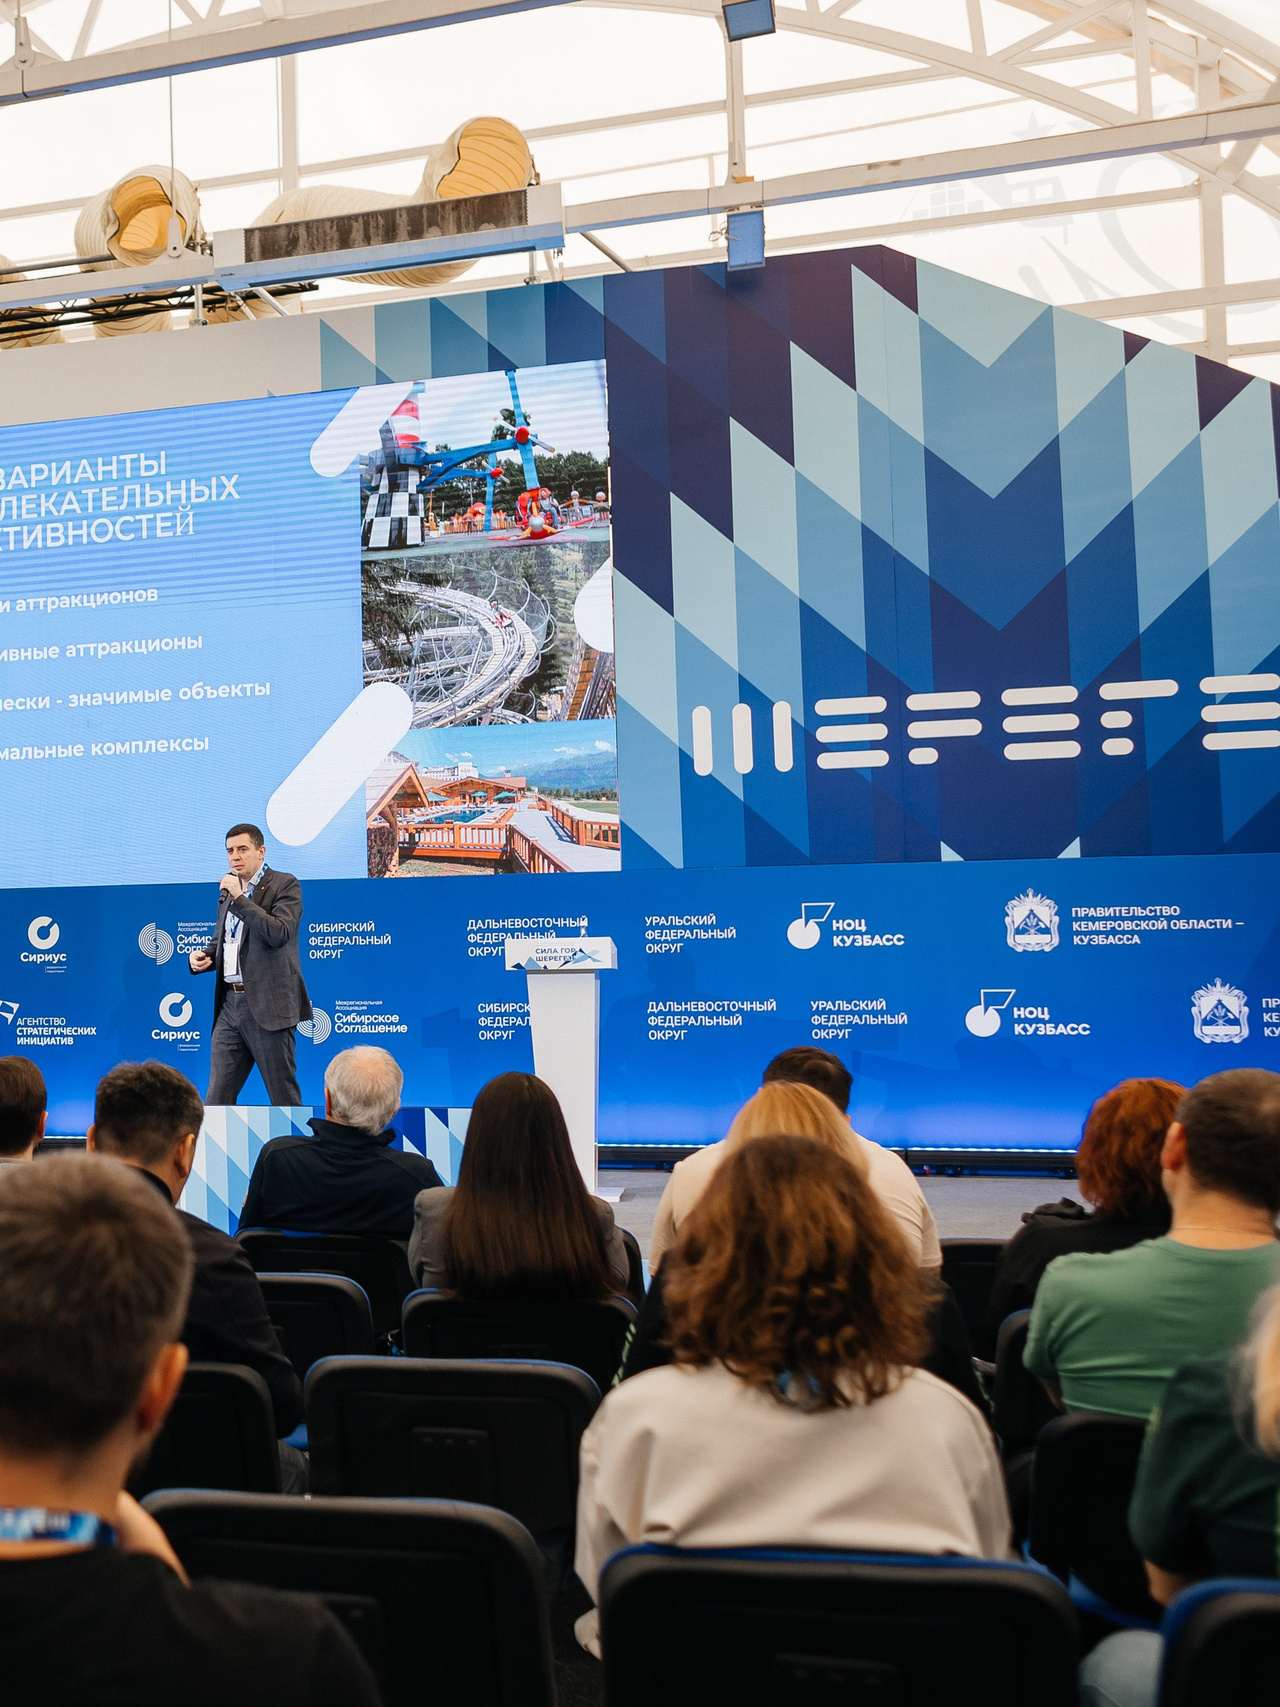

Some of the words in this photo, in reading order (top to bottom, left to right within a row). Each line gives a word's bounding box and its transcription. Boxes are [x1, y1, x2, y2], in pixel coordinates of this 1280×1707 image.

[15, 587, 159, 613] аттракционов
[65, 635, 203, 660] аттракционы
[68, 687, 172, 708] значимые
[179, 681, 271, 701] объекты
[91, 735, 210, 759] комплексы
[1072, 905, 1180, 918] ПРАВИТЕЛЬСТВО
[467, 915, 588, 931] ДАЛЬНЕВОСТОЧНЫЙ
[645, 913, 716, 926] УРАЛЬСКИЙ
[832, 919, 867, 932] НОЦ
[1072, 918, 1168, 931] КЕМЕРОВСКОЙ
[1170, 919, 1232, 930] ОБЛАСТИ
[308, 920, 375, 933] СИБИРСКИЙ
[177, 934, 212, 945] Сибир
[308, 934, 392, 947] ФЕДЕРАЛЬНЫЙ
[645, 927, 736, 941] ФЕДЕРАЛЬНЫЙ
[833, 934, 905, 947] КУЗБАСС
[1073, 935, 1141, 945] КУЗБАССА
[309, 949, 344, 960] ОКРУГ
[468, 946, 505, 957] ОКРУГ
[645, 943, 683, 954] ОКРУГ
[20, 952, 67, 964] Сириус
[478, 1003, 530, 1013] СИБИРСК
[647, 999, 777, 1014] ДАЛЬНЕВОСТОЧНЫЙ
[811, 998, 886, 1011] УРАЛЬСКИЙ
[334, 1012, 400, 1025] Сибирское
[811, 1012, 908, 1027] ФЕДЕРАЛЬНЫЙ
[1013, 1006, 1050, 1021] НОЦ
[17, 1017, 66, 1026] АГЕНТСТВО
[478, 1016, 531, 1028] ФЕДЕРАЛ
[647, 1014, 742, 1028] ФЕДЕРАЛЬНЫЙ
[16, 1026, 97, 1036] СТРАТЕГИЧЕСКИХ
[334, 1023, 408, 1033] Соглашение
[648, 1029, 688, 1040] ОКРУГ
[812, 1029, 852, 1039] ОКРУГ
[1014, 1023, 1091, 1035] КУЗБАСС
[17, 1036, 74, 1046] ИНИЦИАТИВ
[151, 1029, 200, 1041] Сириус
[479, 1030, 515, 1040] ОКРУГ
